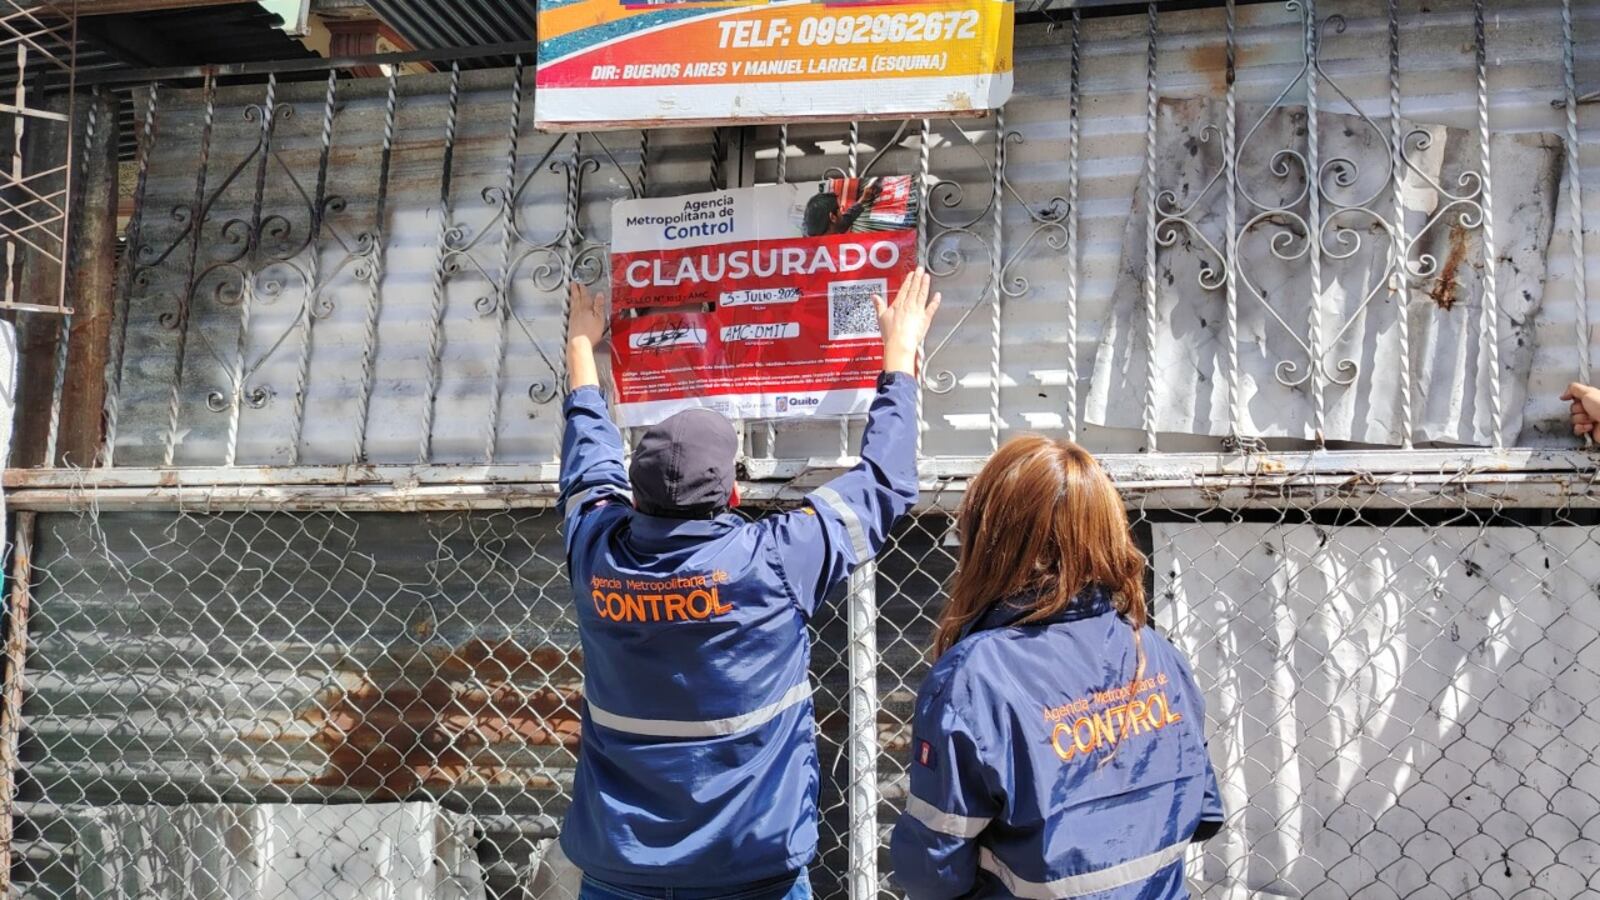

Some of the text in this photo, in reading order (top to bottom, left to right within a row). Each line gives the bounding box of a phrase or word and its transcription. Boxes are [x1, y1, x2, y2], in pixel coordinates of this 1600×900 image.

[718, 9, 979, 49] TELF: 0992962672
[591, 52, 947, 80] DIR: BUENOS AIRES Y MANUEL LARREA (ESQUINA)
[684, 195, 734, 212] Agencia
[626, 207, 734, 227] Metropolitana de
[664, 218, 734, 240] Control
[626, 240, 899, 288] CLAUSURADO
[789, 396, 819, 406] Quito
[626, 576, 706, 592] Metropolitana
[711, 568, 729, 583] de
[592, 586, 733, 622] CONTROL
[1044, 698, 1089, 722] Agencia
[1052, 691, 1184, 761] CONTROL
